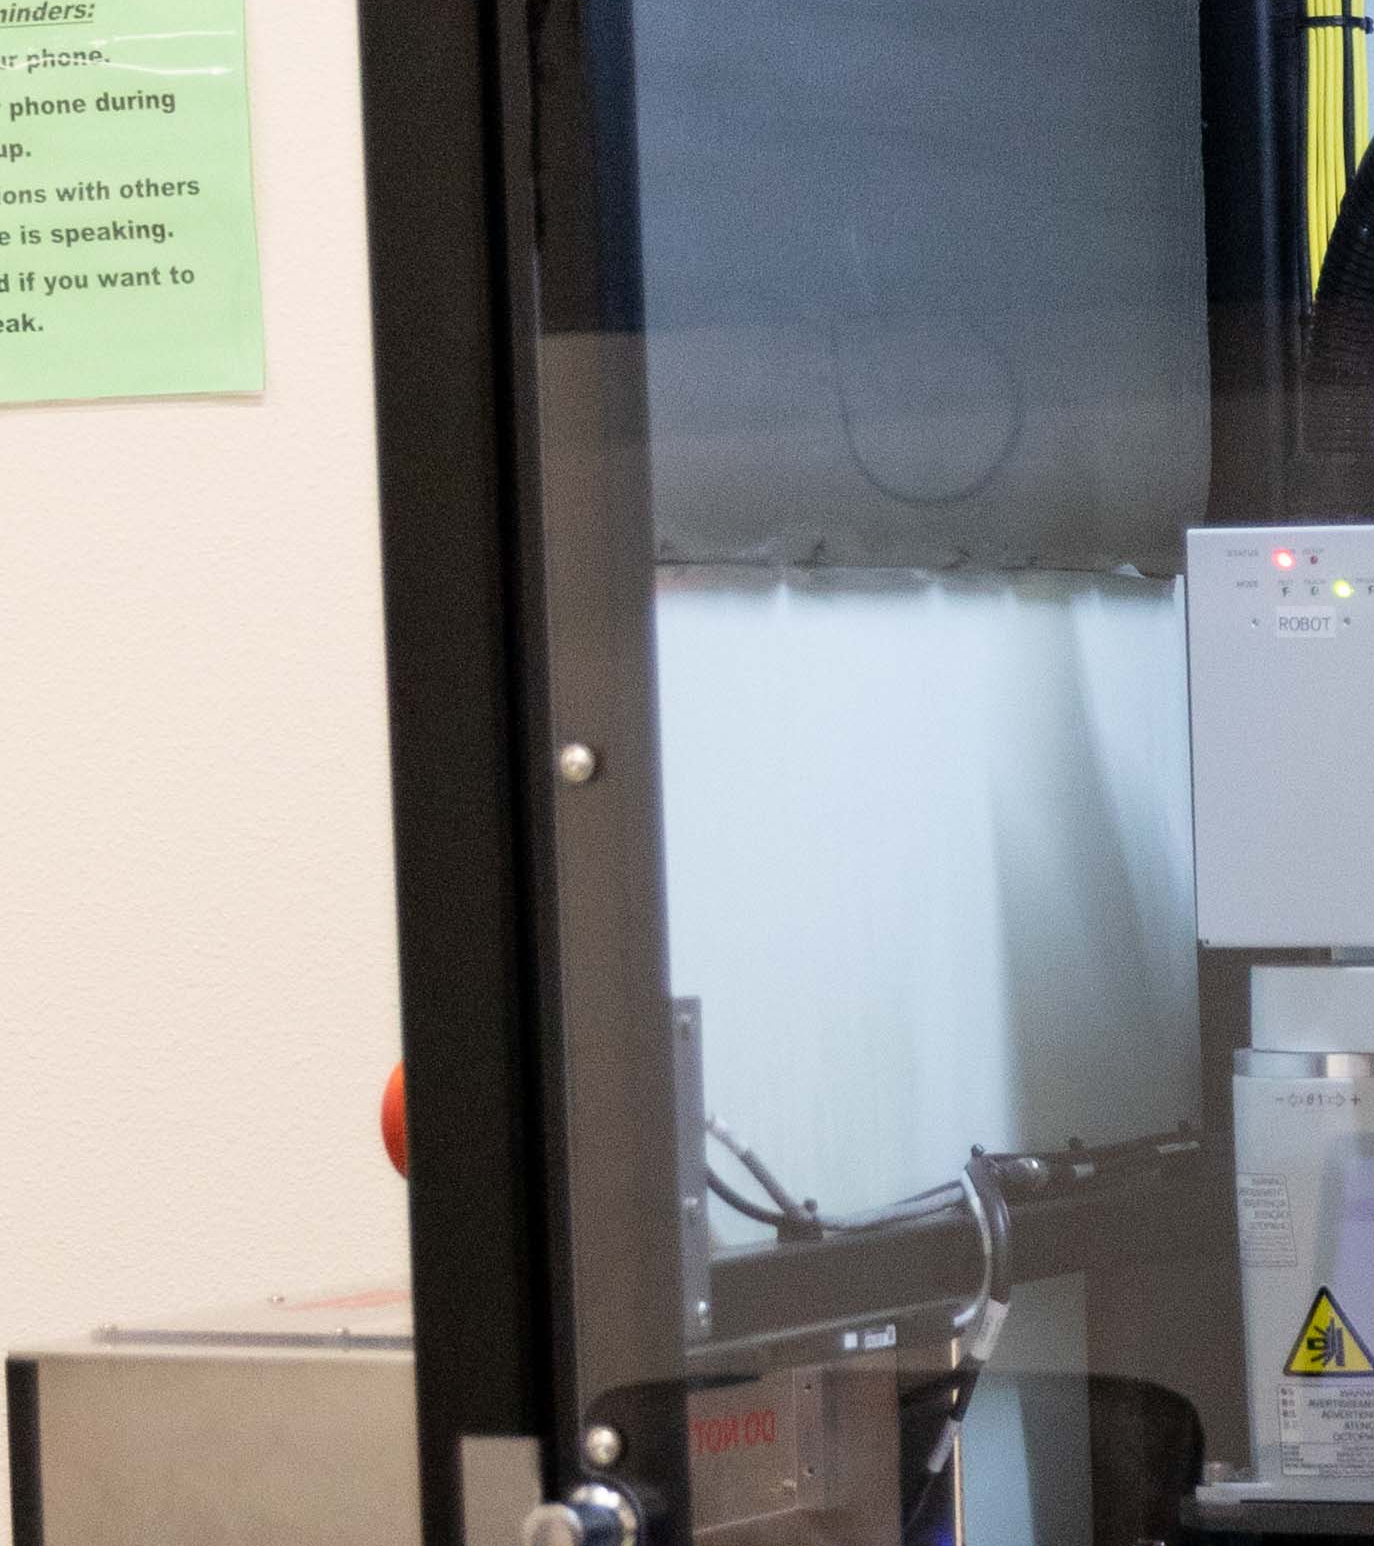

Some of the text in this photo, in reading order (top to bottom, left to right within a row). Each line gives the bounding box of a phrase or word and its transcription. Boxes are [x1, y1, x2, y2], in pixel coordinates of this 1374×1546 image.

[27, 48, 110, 75] phone.
[10, 90, 176, 122] phone during
[0, 178, 201, 205] ons with others
[20, 225, 42, 245] is
[51, 220, 174, 247] speaking.
[19, 271, 36, 292] if
[44, 273, 89, 296] you
[98, 267, 161, 288] want
[169, 266, 195, 285] to
[1278, 616, 1331, 632] ROBOT
